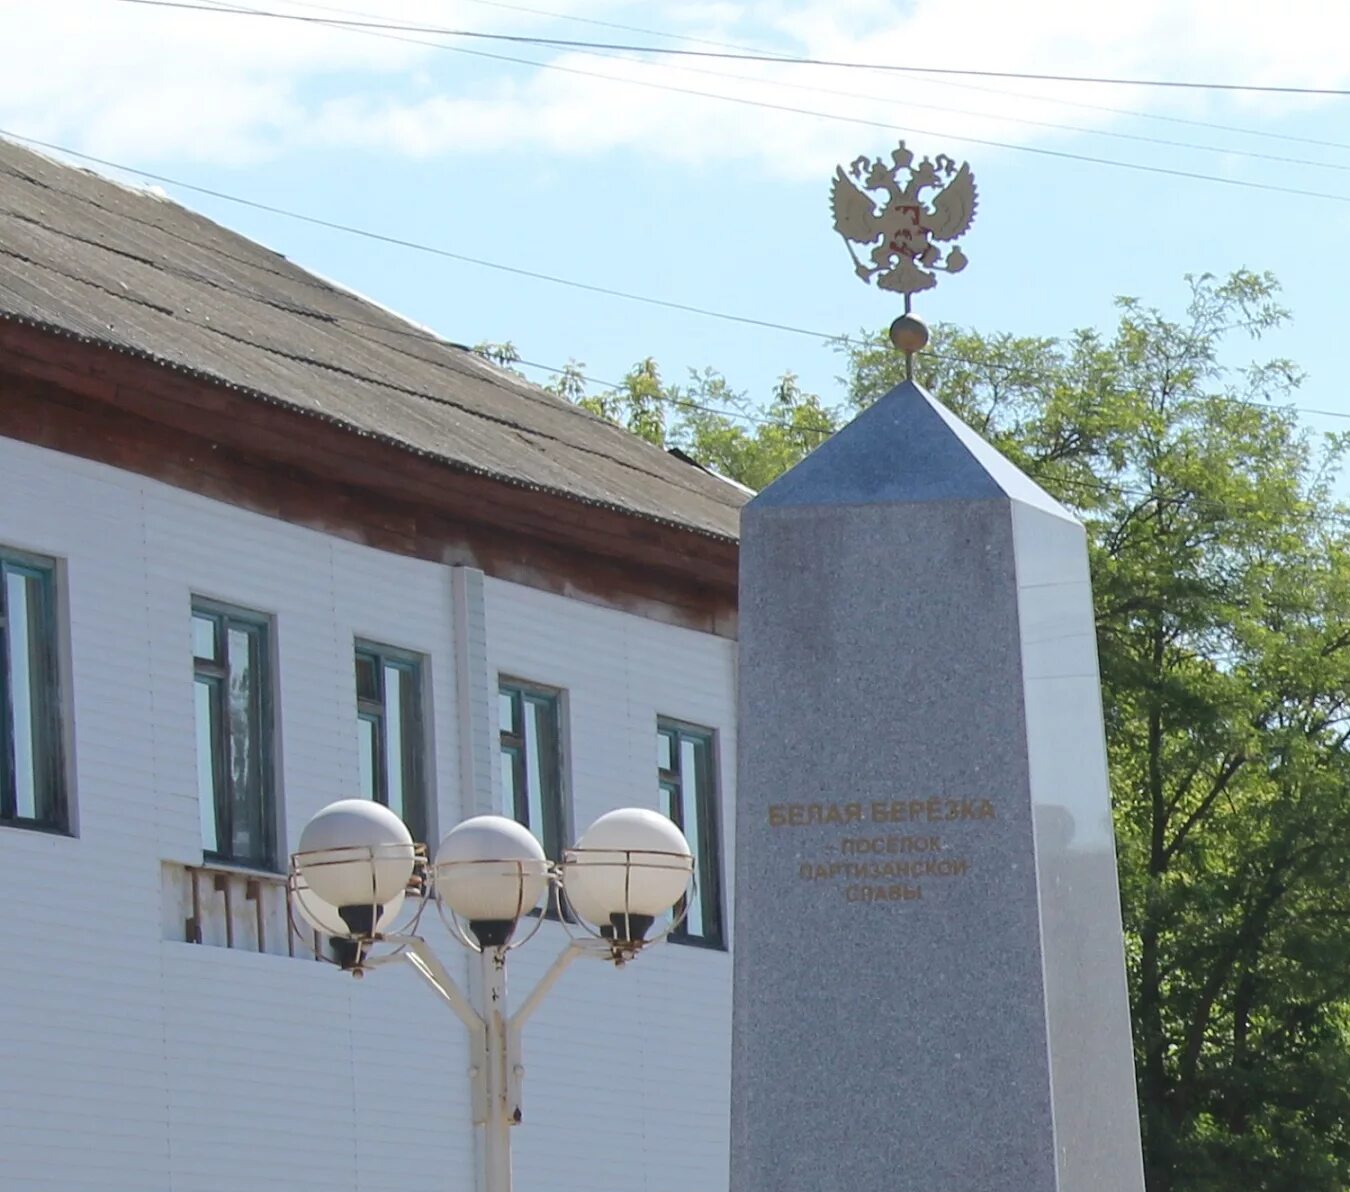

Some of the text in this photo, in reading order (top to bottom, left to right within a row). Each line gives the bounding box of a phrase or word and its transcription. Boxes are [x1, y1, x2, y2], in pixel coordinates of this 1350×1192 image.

[768, 795, 996, 827] БЕЛАЯ БЕРЁЗКА
[799, 857, 968, 881] ПАРТИЗАНСКОЙ
[846, 884, 922, 902] СЛАВЫ
